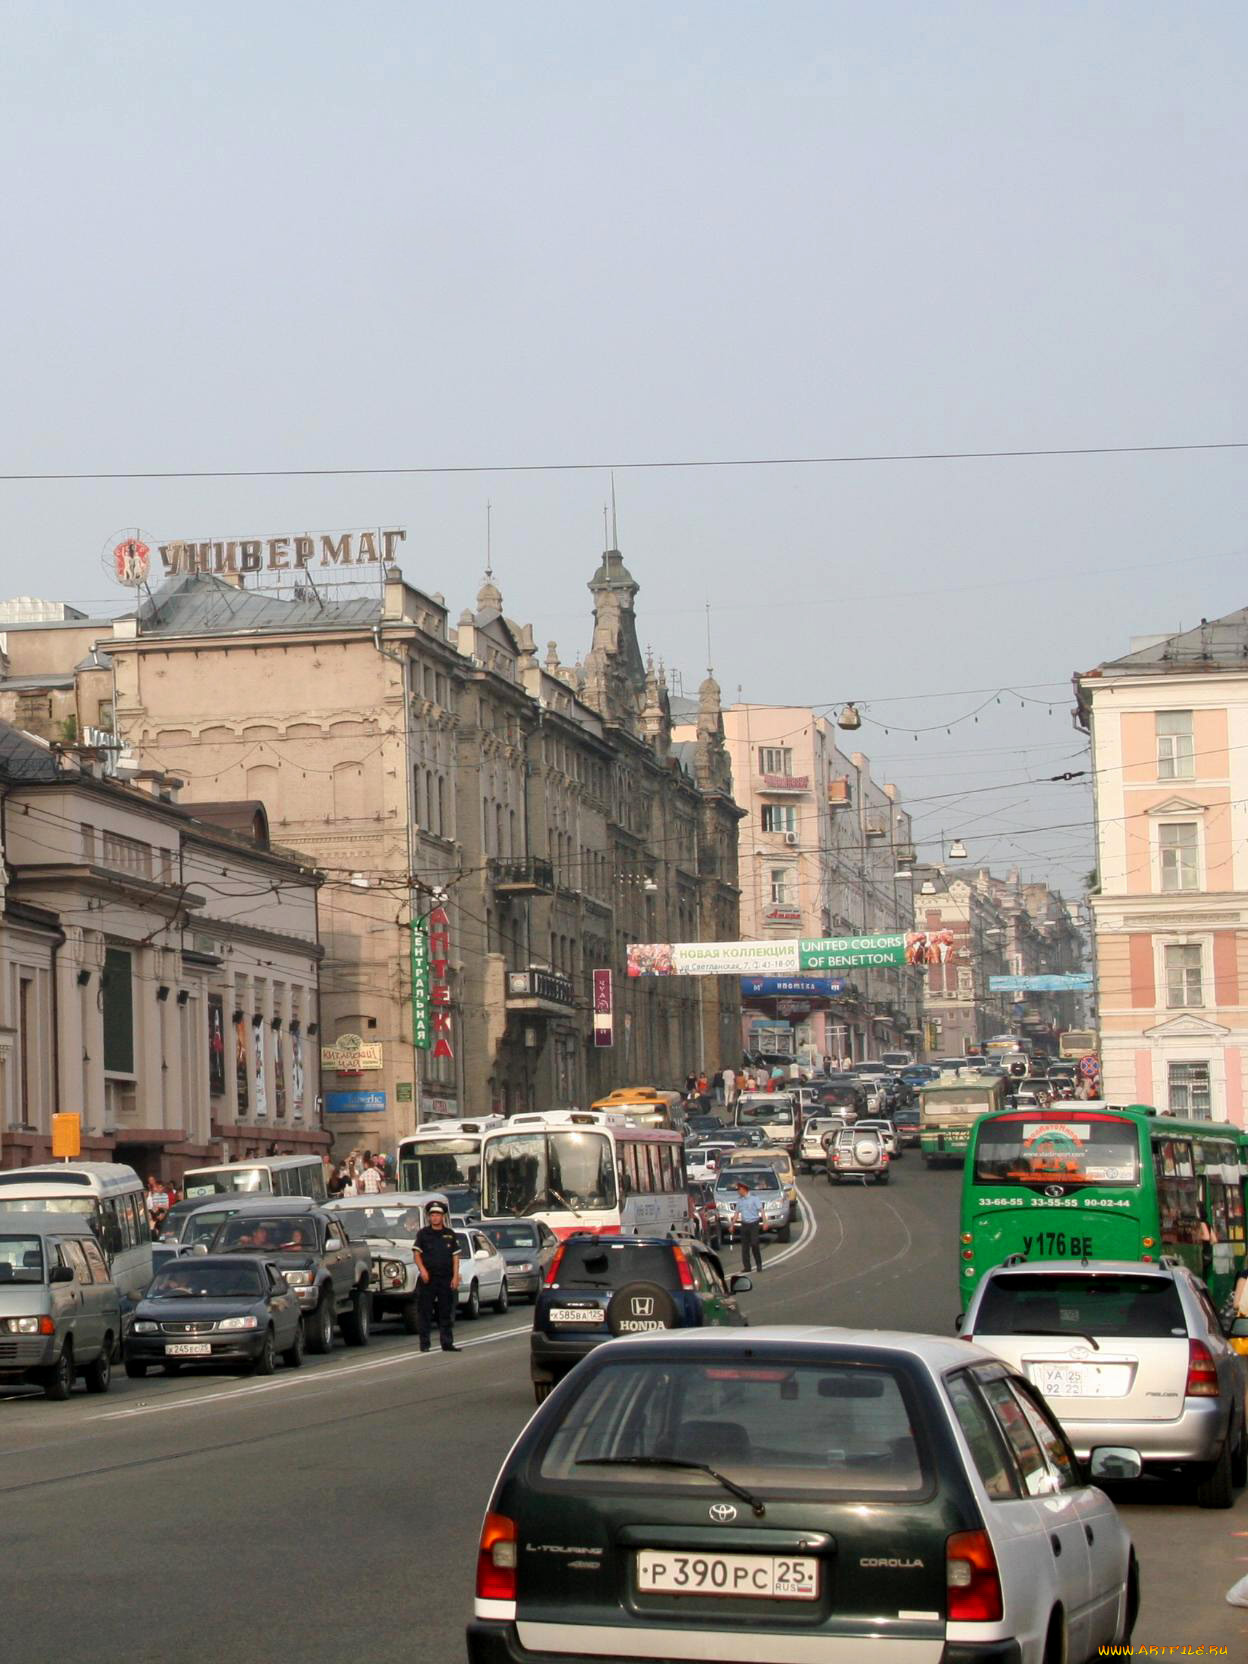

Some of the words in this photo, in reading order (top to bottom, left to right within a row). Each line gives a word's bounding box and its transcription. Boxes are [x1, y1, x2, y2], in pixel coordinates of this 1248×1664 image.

[158, 530, 407, 577] УНИВЕРМАГ
[802, 939, 848, 952] UNITED
[851, 936, 902, 949] COLORS
[679, 949, 720, 959] НОВАЯ
[723, 946, 795, 959] КОЛЛЕКЦИЯ
[808, 957, 825, 968] OF
[828, 953, 897, 967] BENETTON.
[414, 926, 426, 1041] ЦЕНТРАЛЬНАЯ
[431, 907, 453, 1058] АПТЕКА
[1031, 1198, 1078, 1207] 33-55-55
[1084, 1199, 1130, 1207] 90-02-44
[620, 1320, 666, 1331] HONDA
[859, 1556, 925, 1568] COROLLA
[775, 1582, 797, 1593] RUS
